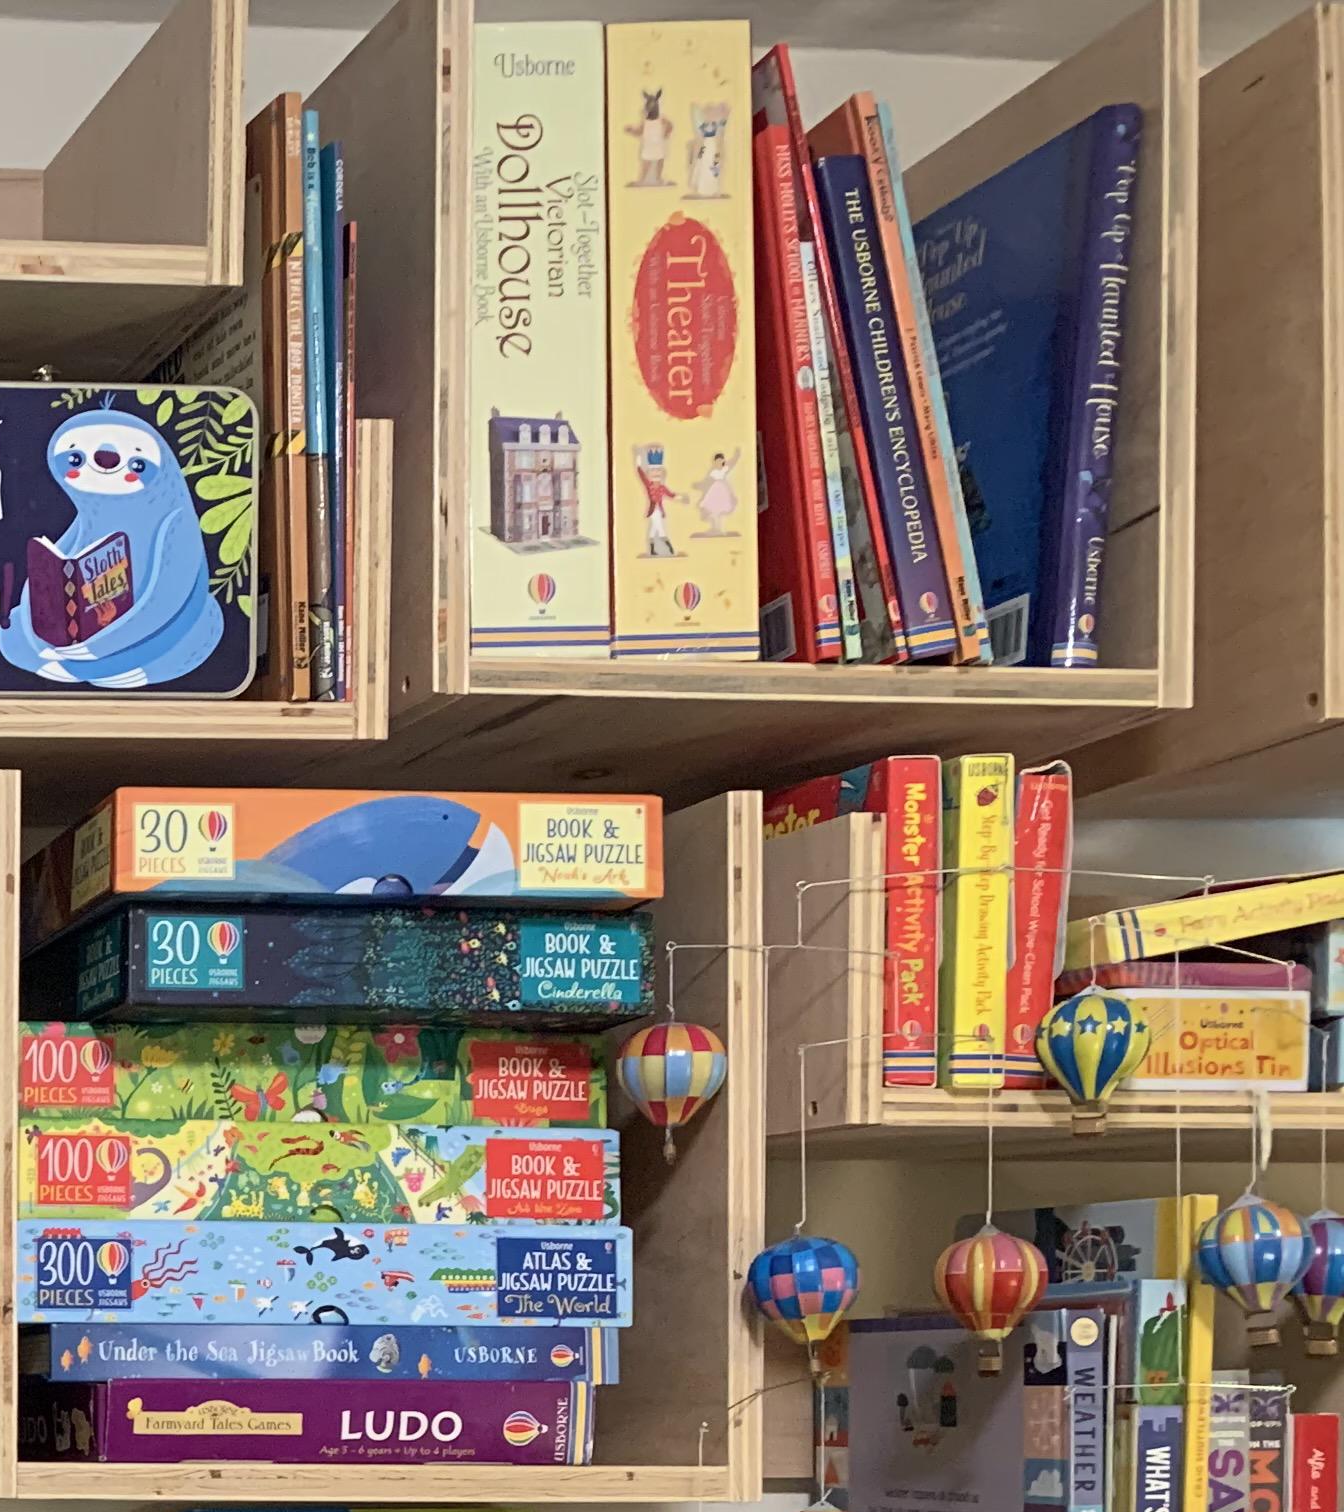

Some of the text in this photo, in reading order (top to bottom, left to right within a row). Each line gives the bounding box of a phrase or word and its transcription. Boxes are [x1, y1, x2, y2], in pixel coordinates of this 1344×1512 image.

[494, 53, 576, 78] Usborne
[496, 114, 545, 358] Dollhouse
[544, 175, 572, 299] Victorian
[666, 234, 707, 407] Theater
[844, 188, 928, 563] THE USBORNE CHILDREN'S ENCYCLOPEDIA
[82, 548, 124, 582] Sloth
[88, 572, 127, 602] Tales
[140, 809, 188, 854] 30
[546, 819, 620, 839] BOOK &
[139, 857, 186, 873] PIECES
[524, 843, 644, 864] JIGSAW PUZZLE
[896, 783, 928, 1007] Monster Activity Pack
[151, 921, 199, 965] 30
[545, 934, 617, 954] BOOK &
[151, 967, 198, 984] PIECES
[524, 959, 639, 979] JIGSAW PUZZLE
[537, 981, 623, 1000] Cinderella
[1179, 1030, 1254, 1052] Optical
[24, 1040, 76, 1082] 100
[1147, 1053, 1246, 1077] Illusions
[24, 1086, 77, 1103] PIECES
[39, 1243, 92, 1284] 300
[523, 1253, 593, 1271] ATLAS &
[499, 1272, 616, 1294] JIGSAW PUZZLE
[39, 1288, 93, 1306] PIECES
[506, 1295, 611, 1315] The World
[98, 1340, 359, 1366] Under the Sea Jigsaw Book
[454, 1347, 537, 1364] USBORNE
[145, 1416, 291, 1434] Farmyard Tales Games
[341, 1410, 462, 1442] LUDO
[1073, 1367, 1097, 1492] WEATHER
